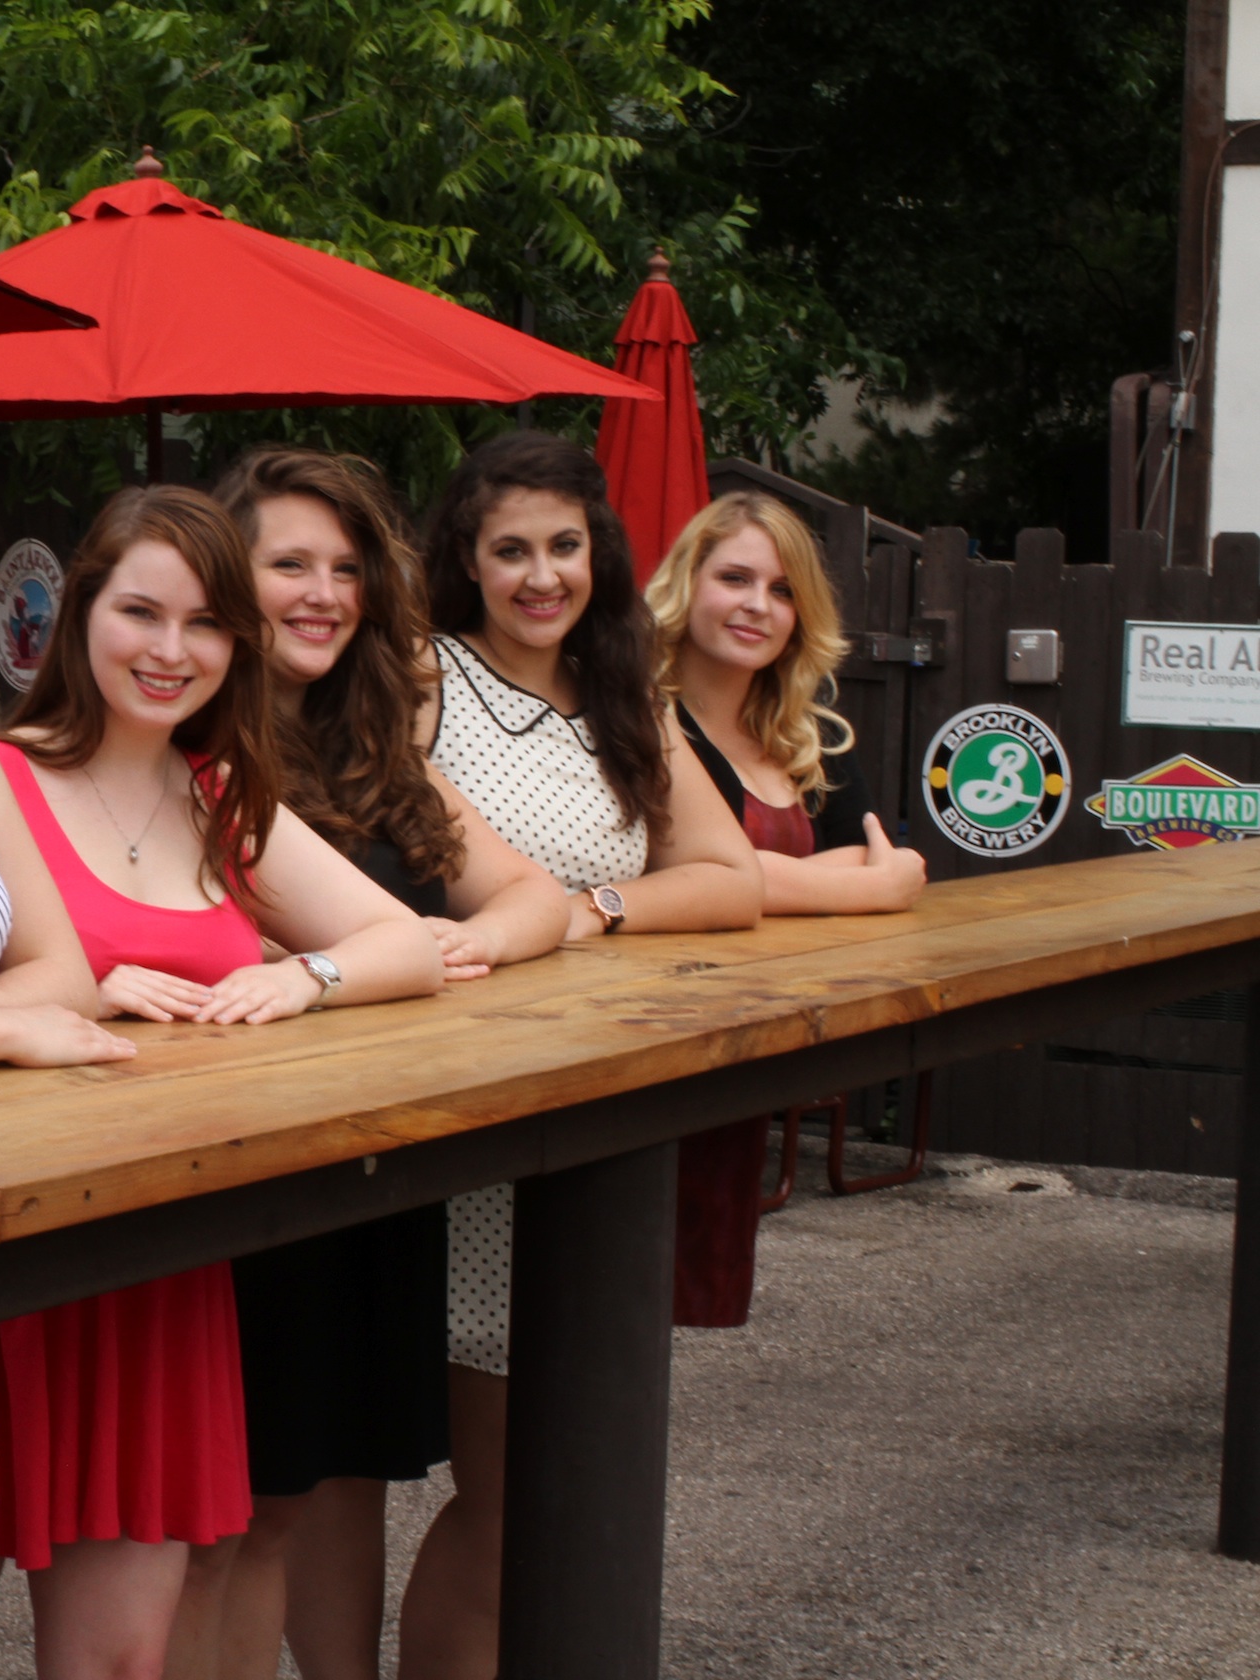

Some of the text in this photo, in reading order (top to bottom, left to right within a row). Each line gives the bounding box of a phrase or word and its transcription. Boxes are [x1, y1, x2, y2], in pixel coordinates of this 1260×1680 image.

[1141, 634, 1217, 670] Real
[1139, 669, 1260, 690] Brewing Company
[942, 712, 1054, 758] BROOKLYN
[1111, 789, 1258, 823] BOULEVARD
[940, 806, 1048, 849] BREWERY
[1134, 819, 1212, 840] BREWING
